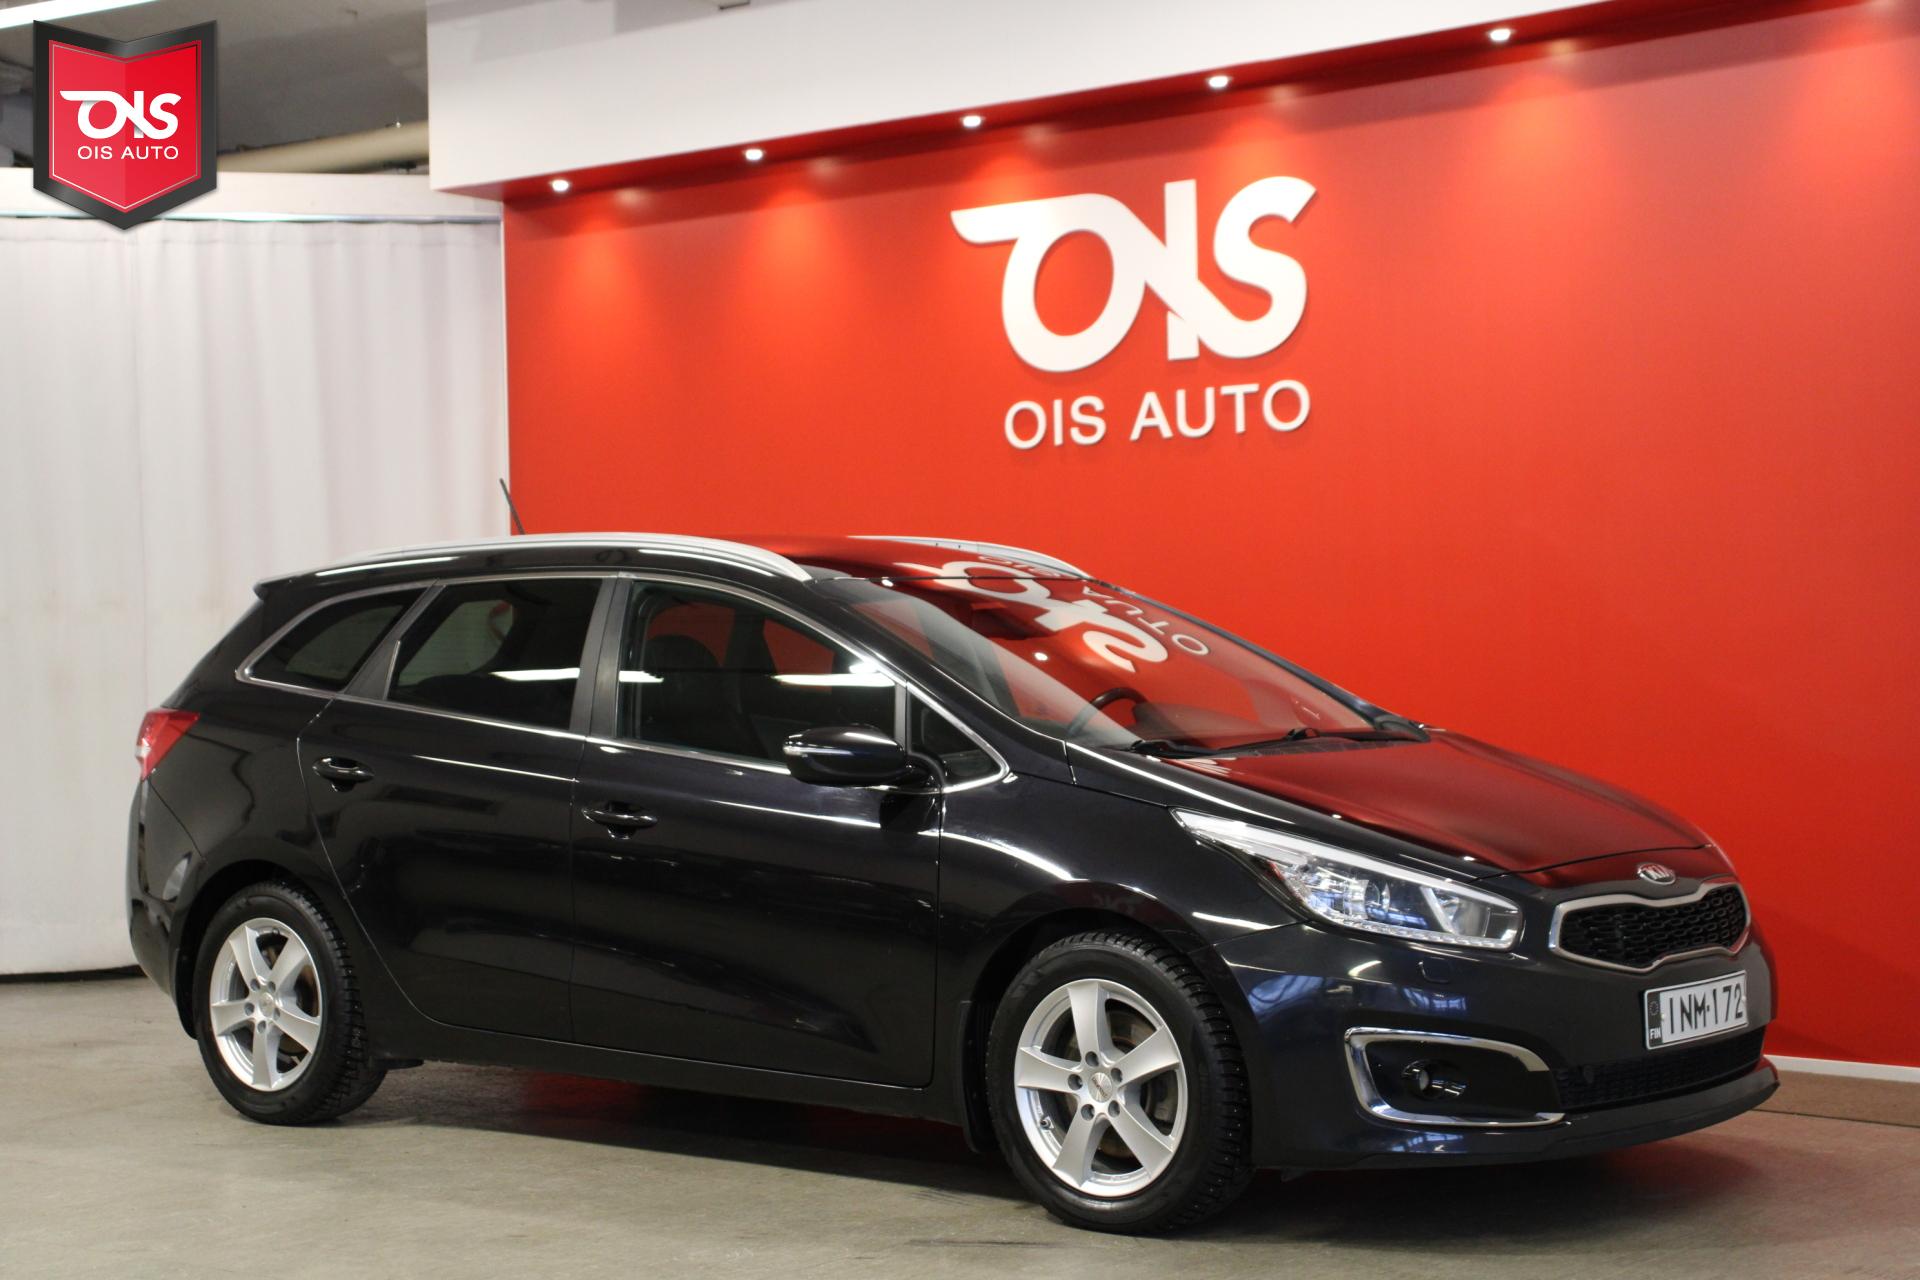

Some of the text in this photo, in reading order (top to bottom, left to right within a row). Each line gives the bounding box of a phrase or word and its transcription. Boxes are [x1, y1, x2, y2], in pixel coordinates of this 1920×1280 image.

[950, 176, 1317, 373] OIS
[1004, 380, 1311, 450] OIS AUTO
[1650, 1027, 1661, 1039] FIN
[1669, 983, 1743, 1034] INM-172
